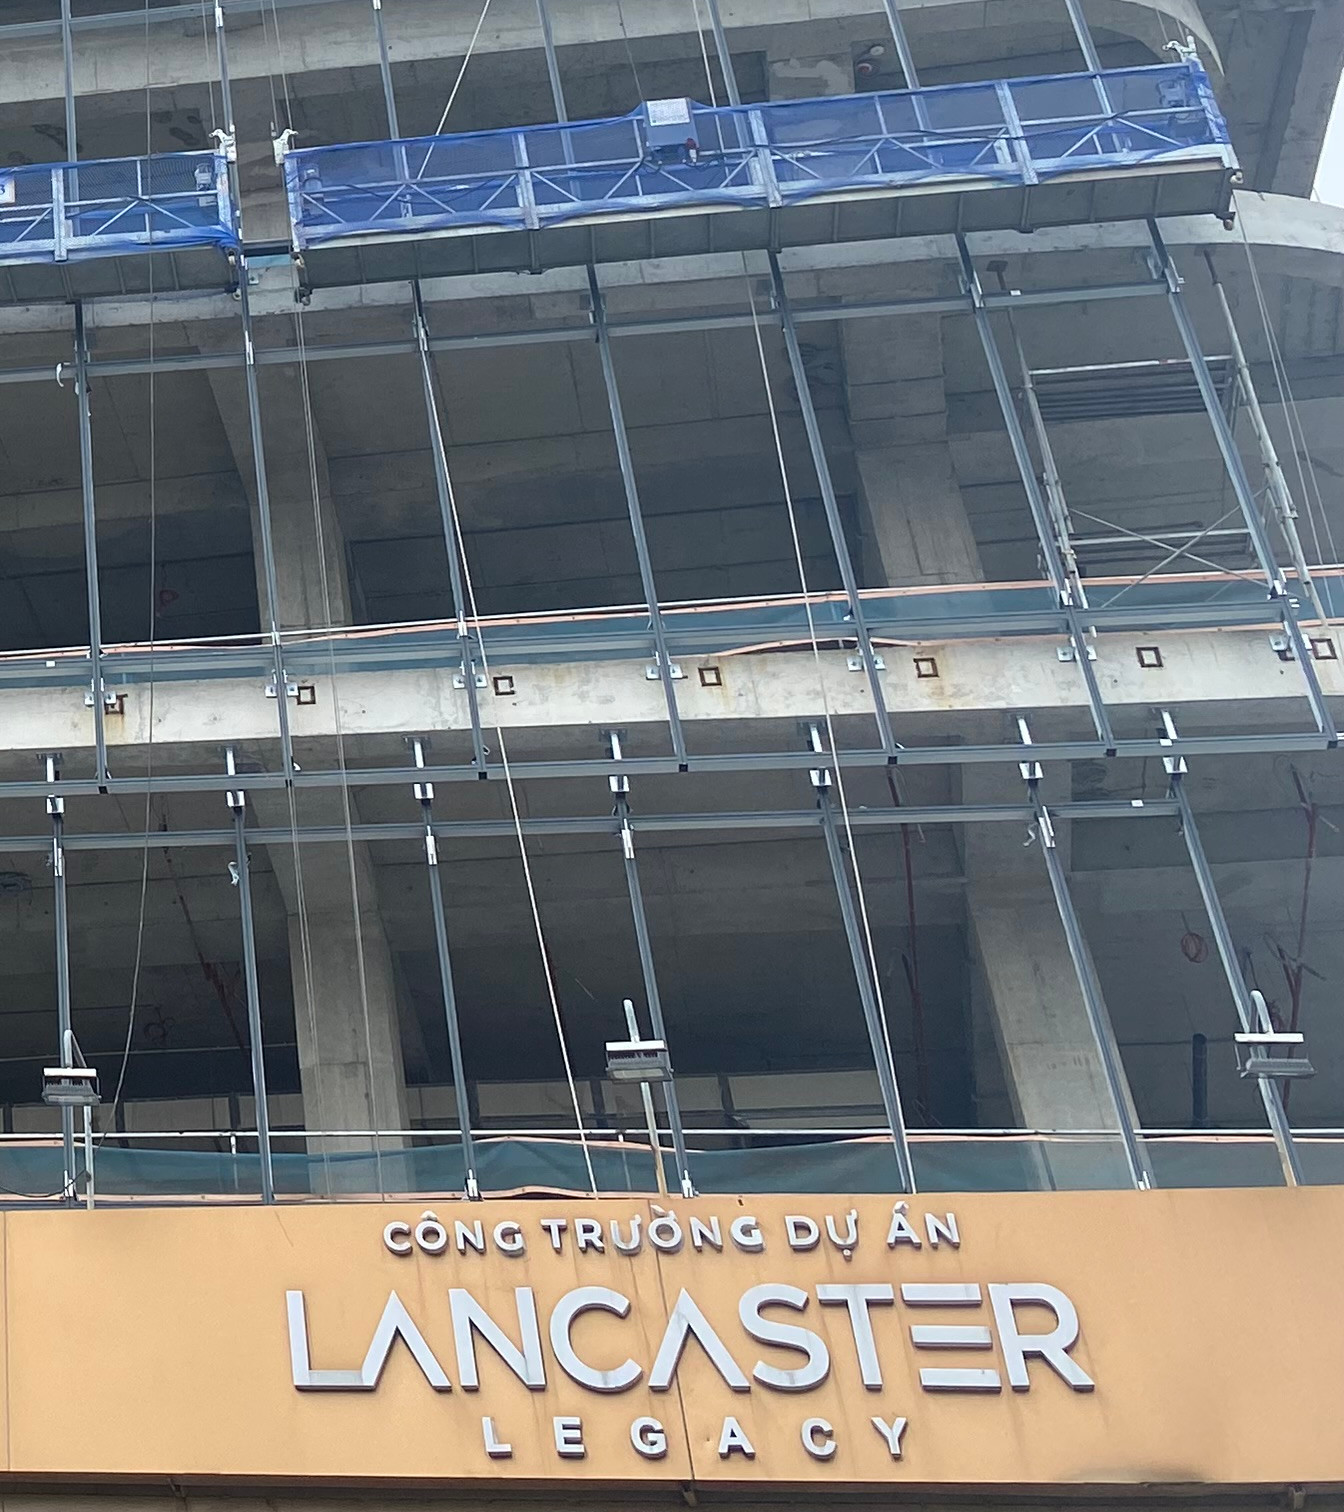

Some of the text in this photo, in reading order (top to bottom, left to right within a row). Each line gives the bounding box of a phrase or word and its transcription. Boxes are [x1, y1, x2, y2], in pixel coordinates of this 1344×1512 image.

[383, 1210, 526, 1256] CÔNG
[541, 1205, 765, 1254] TRƯỜNG
[784, 1209, 859, 1261] DỰ
[285, 1282, 1096, 1393] LANCASTER
[481, 1416, 908, 1460] LEGACY
